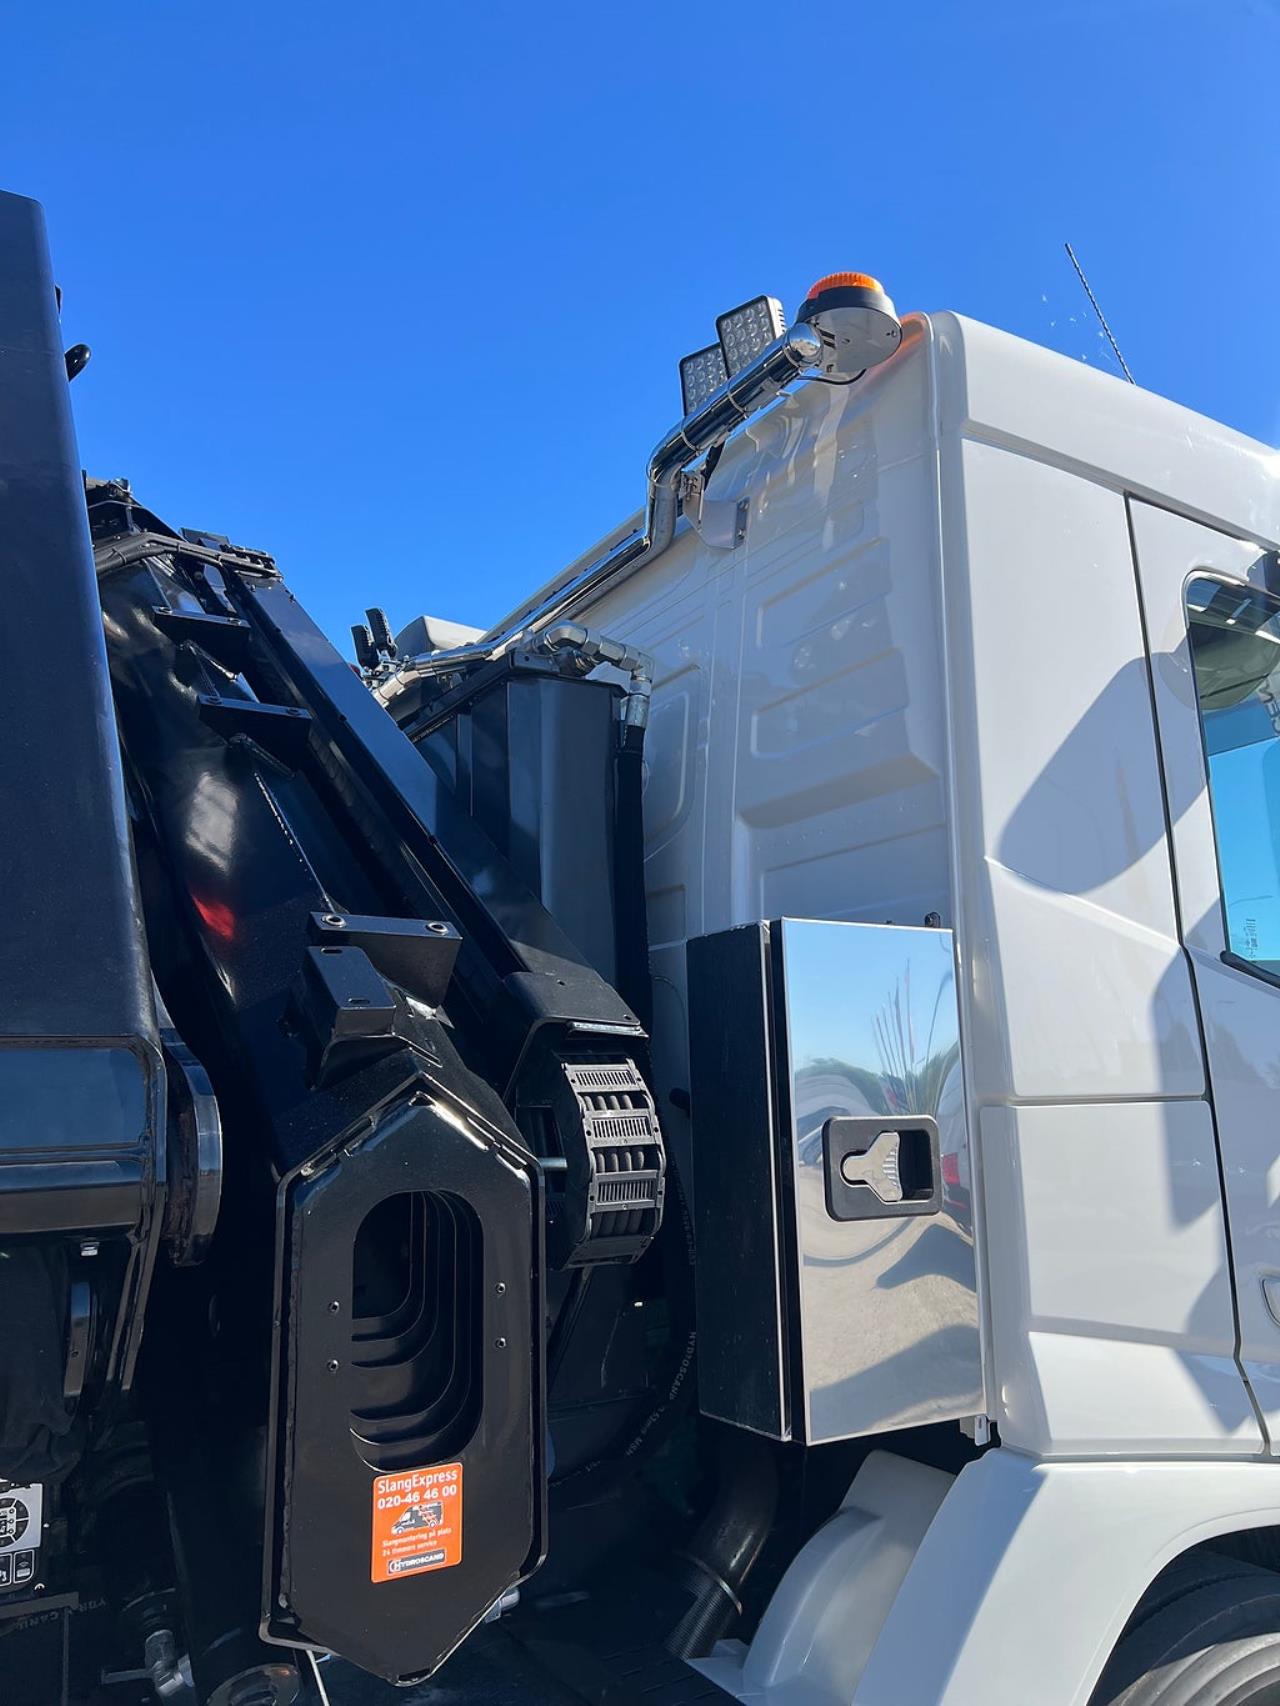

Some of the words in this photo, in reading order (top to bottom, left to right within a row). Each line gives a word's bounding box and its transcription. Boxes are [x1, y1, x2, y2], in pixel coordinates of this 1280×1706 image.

[377, 1470, 458, 1494] SlangExpress
[377, 1491, 420, 1509] 020-46
[423, 1487, 439, 1499] 46
[442, 1484, 457, 1497] 00
